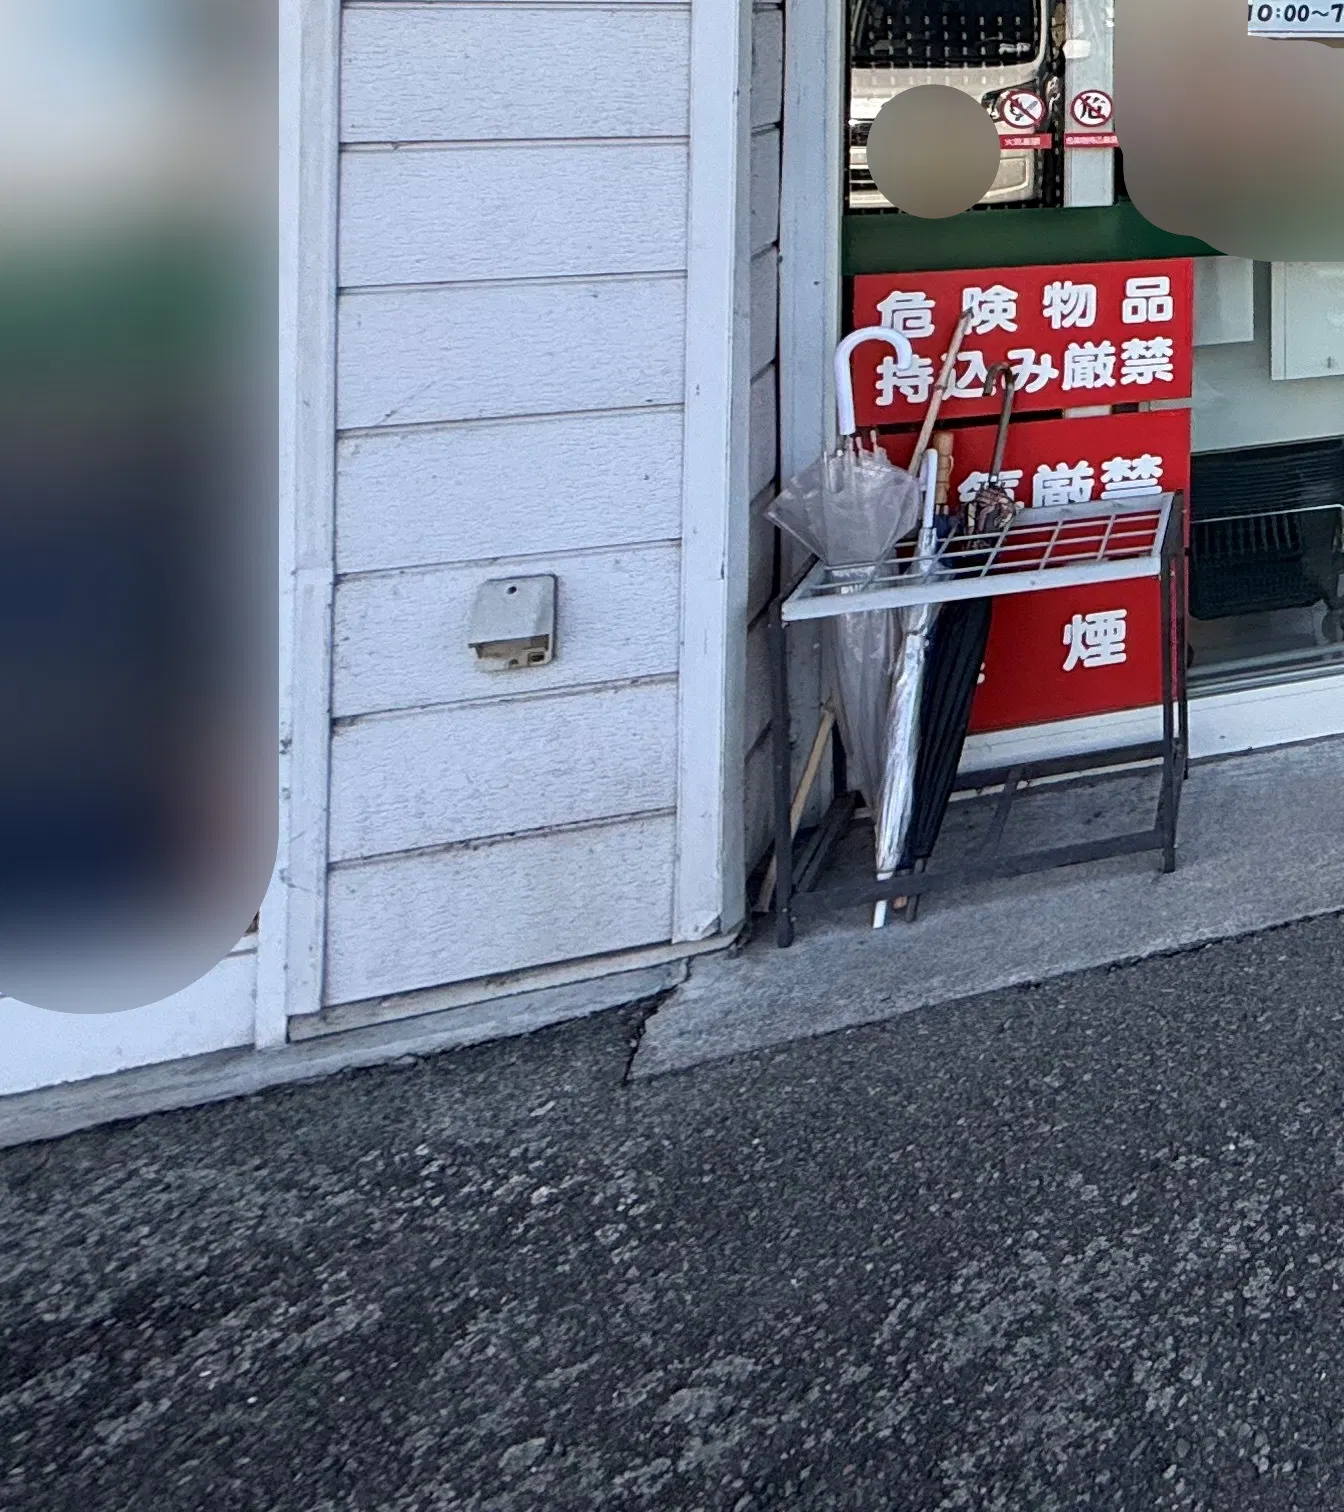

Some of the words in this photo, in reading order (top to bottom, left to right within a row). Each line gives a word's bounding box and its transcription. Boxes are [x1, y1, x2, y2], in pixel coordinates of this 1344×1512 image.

[876, 276, 1174, 338] 危険物品
[876, 336, 1174, 406] 持込み厳禁
